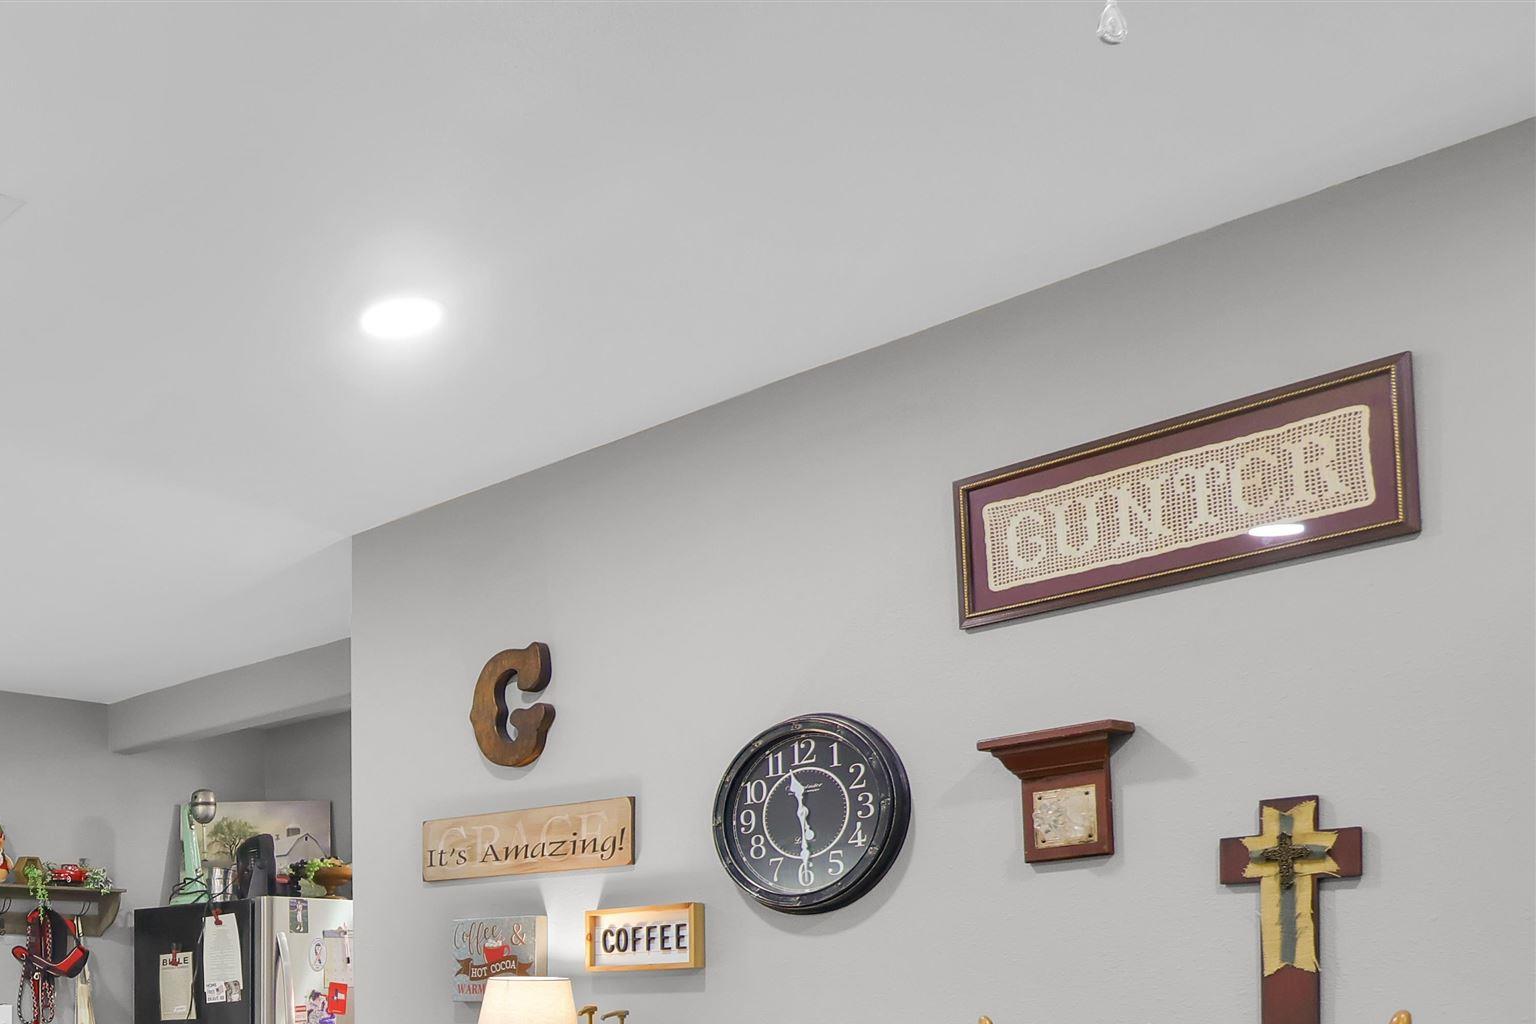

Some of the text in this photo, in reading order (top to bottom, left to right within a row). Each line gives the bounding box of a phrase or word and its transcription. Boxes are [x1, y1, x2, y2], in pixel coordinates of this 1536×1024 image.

[1007, 432, 1351, 572] GUNTER
[470, 642, 556, 767] G
[765, 751, 785, 778] 11
[790, 738, 817, 766] 12
[829, 742, 842, 767] 1
[849, 763, 866, 789] 2
[743, 779, 767, 805] 10
[857, 792, 875, 818] 3
[740, 809, 756, 834] 9
[848, 822, 866, 847] 4
[427, 827, 626, 868] It's Amazing!
[750, 835, 766, 860] 8
[769, 857, 784, 882] 7
[798, 861, 814, 887] 6
[828, 850, 844, 876] 5
[453, 922, 500, 955] Coffee
[602, 922, 687, 953] COFFEE
[162, 957, 189, 966] BILE
[471, 960, 516, 978] HOT COCOA
